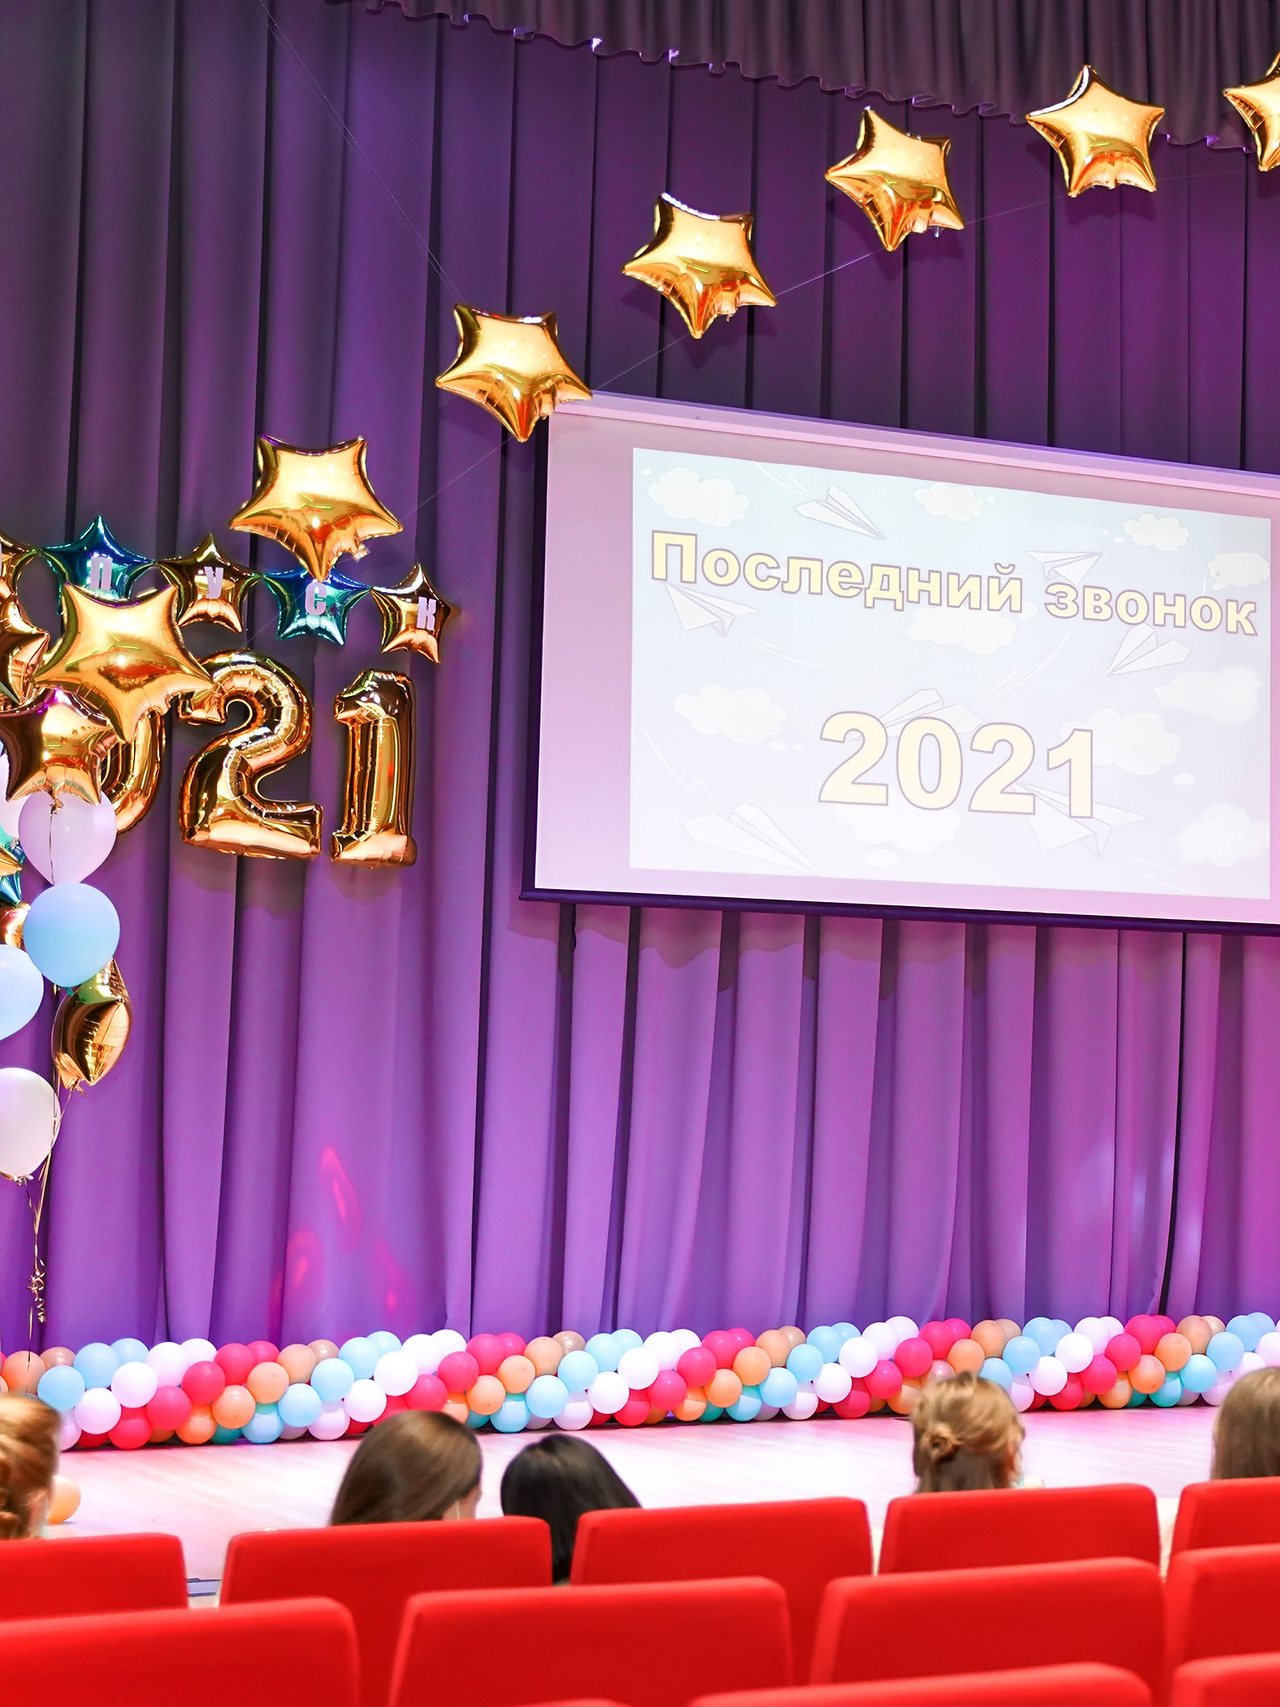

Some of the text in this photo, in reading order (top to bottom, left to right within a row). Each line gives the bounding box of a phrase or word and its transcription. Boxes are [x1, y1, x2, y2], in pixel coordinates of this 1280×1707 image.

[0, 542, 438, 632] ПУСК
[652, 530, 1258, 636] Последний звонок
[818, 711, 1094, 819] 2021
